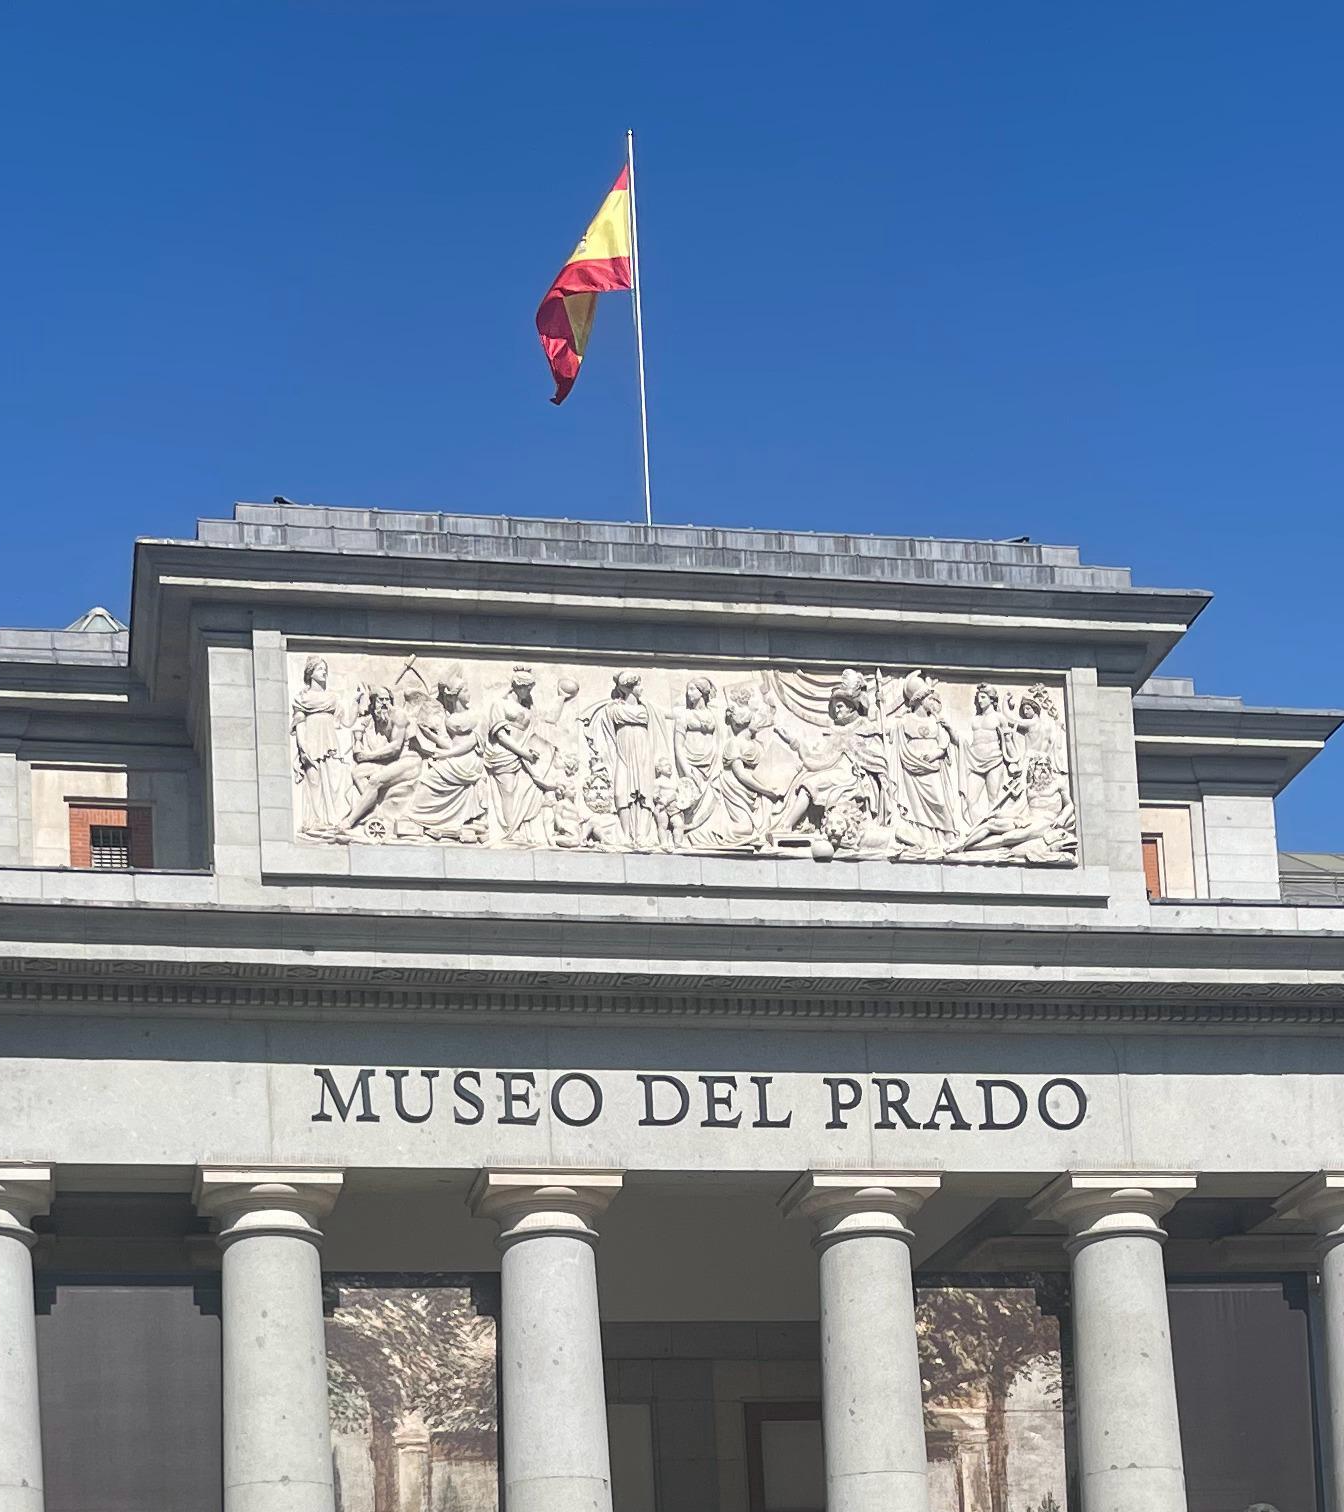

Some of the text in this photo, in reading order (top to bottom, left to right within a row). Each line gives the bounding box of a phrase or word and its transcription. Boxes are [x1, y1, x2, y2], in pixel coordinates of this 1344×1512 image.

[311, 1067, 1089, 1132] MUSEO DEL PRADO
